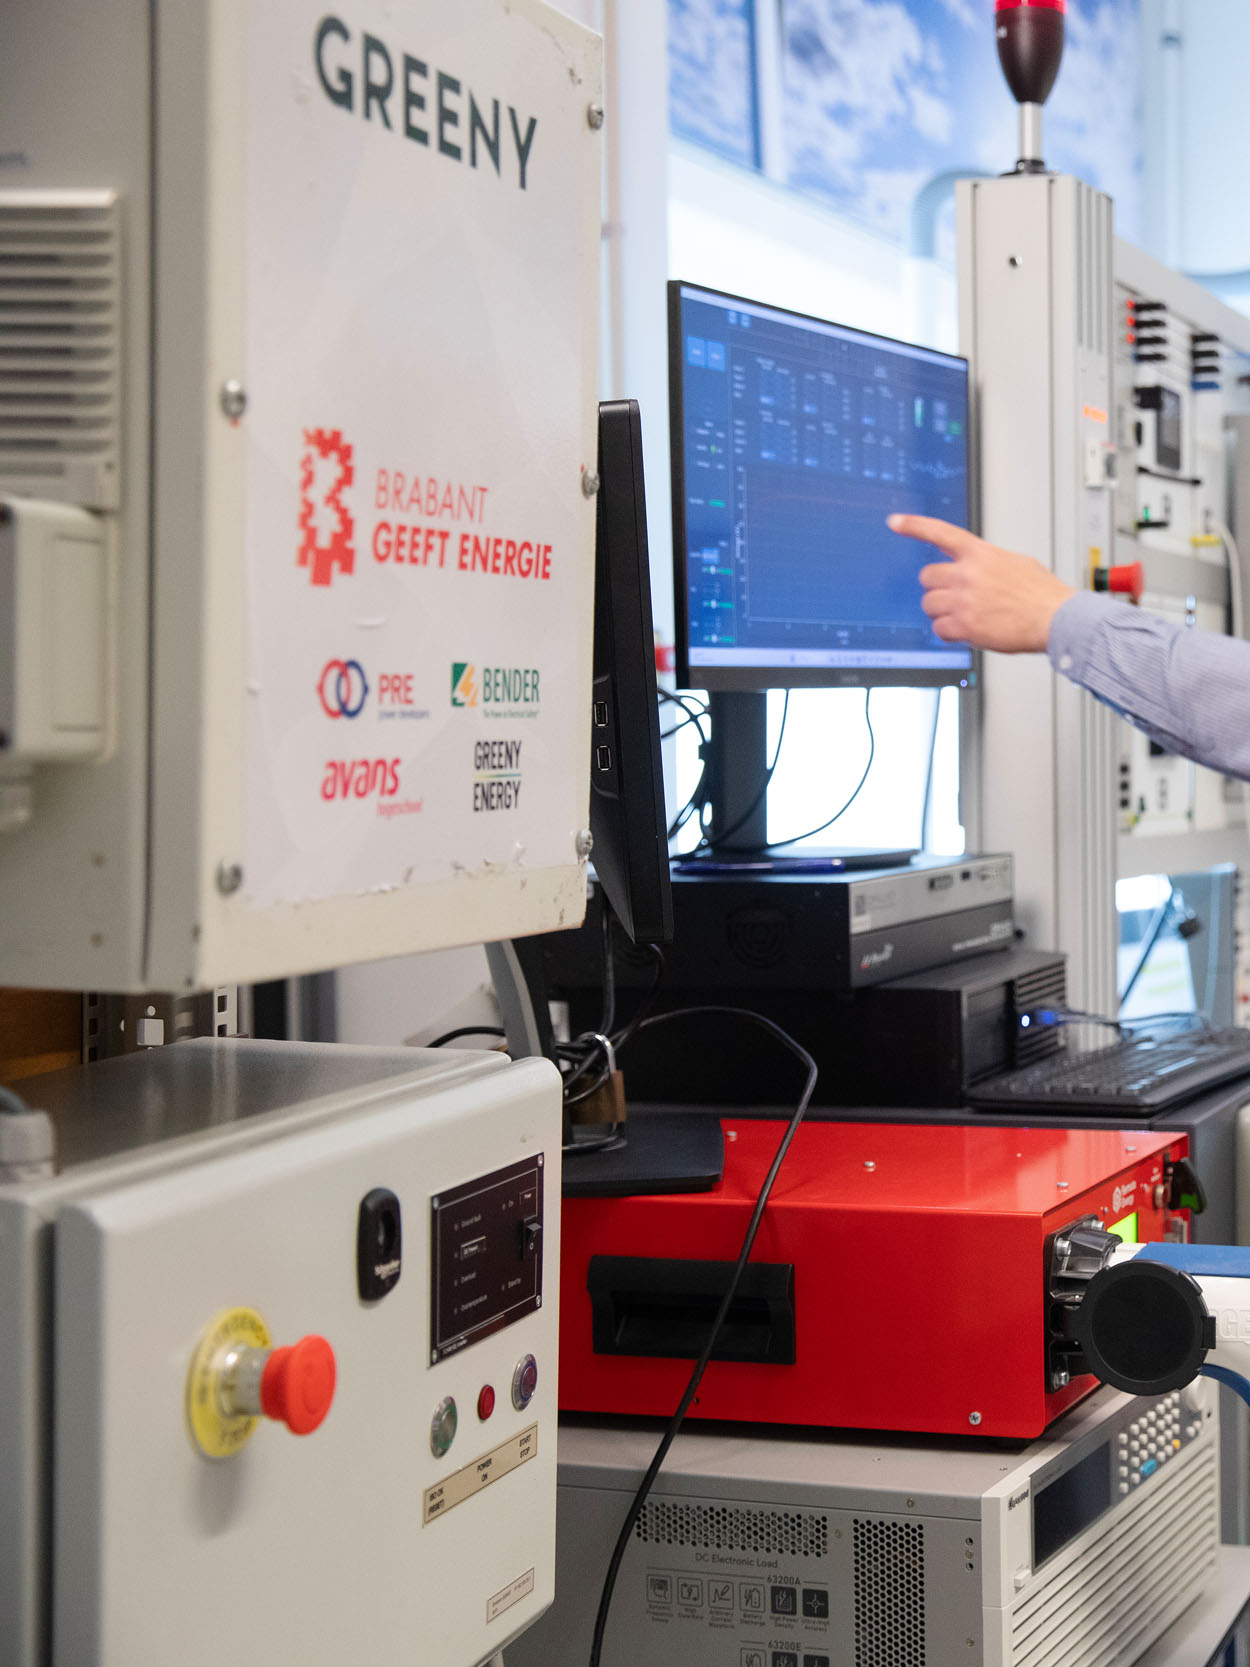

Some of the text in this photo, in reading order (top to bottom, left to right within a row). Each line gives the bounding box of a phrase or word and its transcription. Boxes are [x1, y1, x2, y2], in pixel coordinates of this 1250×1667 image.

[314, 14, 538, 191] GREENY
[374, 467, 489, 524] BRABANT
[371, 520, 553, 580] GEEFT ENERGIE
[378, 673, 415, 705] PRE
[483, 667, 541, 703] BENDER
[473, 740, 522, 770] GREENY
[320, 756, 401, 802] avans
[473, 780, 522, 812] ENERGY
[695, 1552, 779, 1569] DC Electronic Load
[767, 1574, 801, 1586] 63200A
[768, 1639, 802, 1651] 63200E
